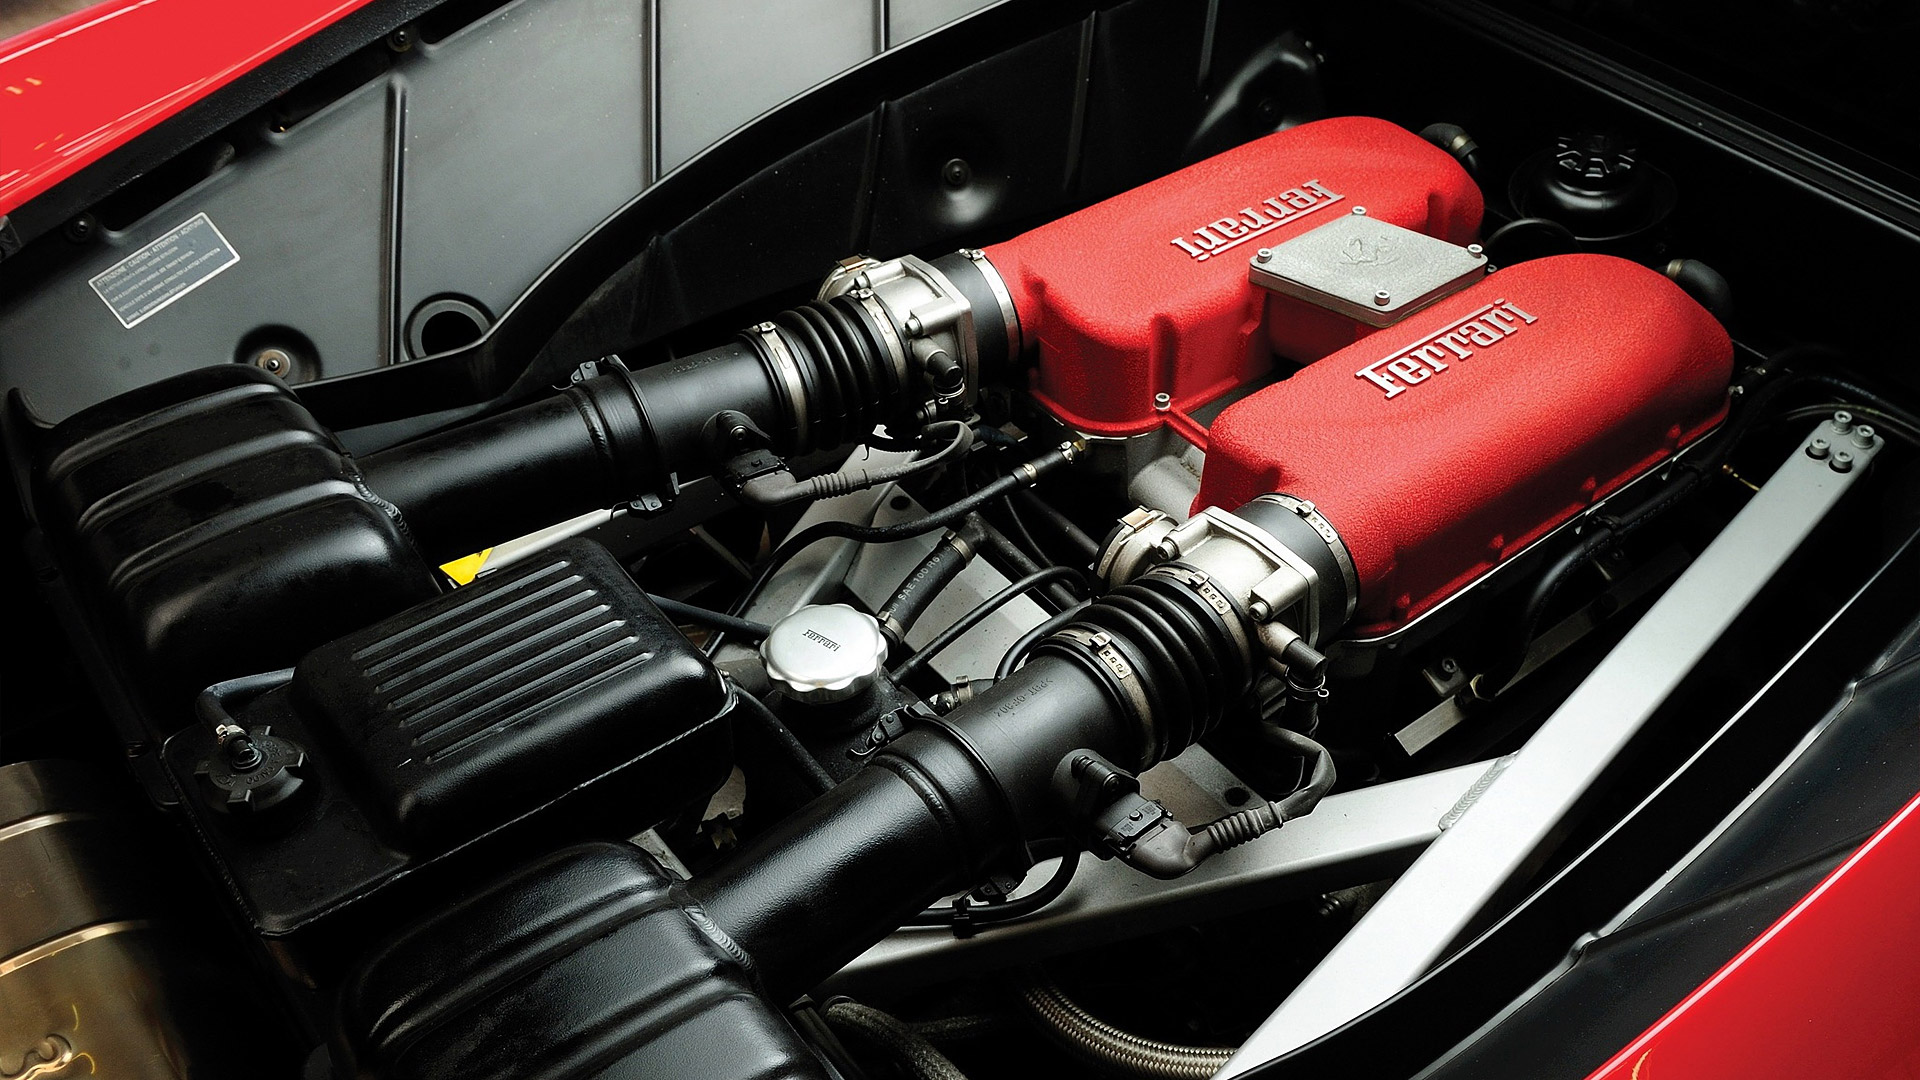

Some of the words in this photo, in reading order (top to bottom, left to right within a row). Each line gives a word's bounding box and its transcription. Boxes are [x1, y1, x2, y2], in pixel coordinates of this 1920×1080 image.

[1170, 179, 1345, 261] Ferrari
[128, 250, 151, 267] CAUTION
[152, 234, 179, 253] ATTENTION
[1355, 298, 1538, 399] Ferrari
[898, 582, 916, 601] SAE
[802, 629, 841, 652] Ferrari
